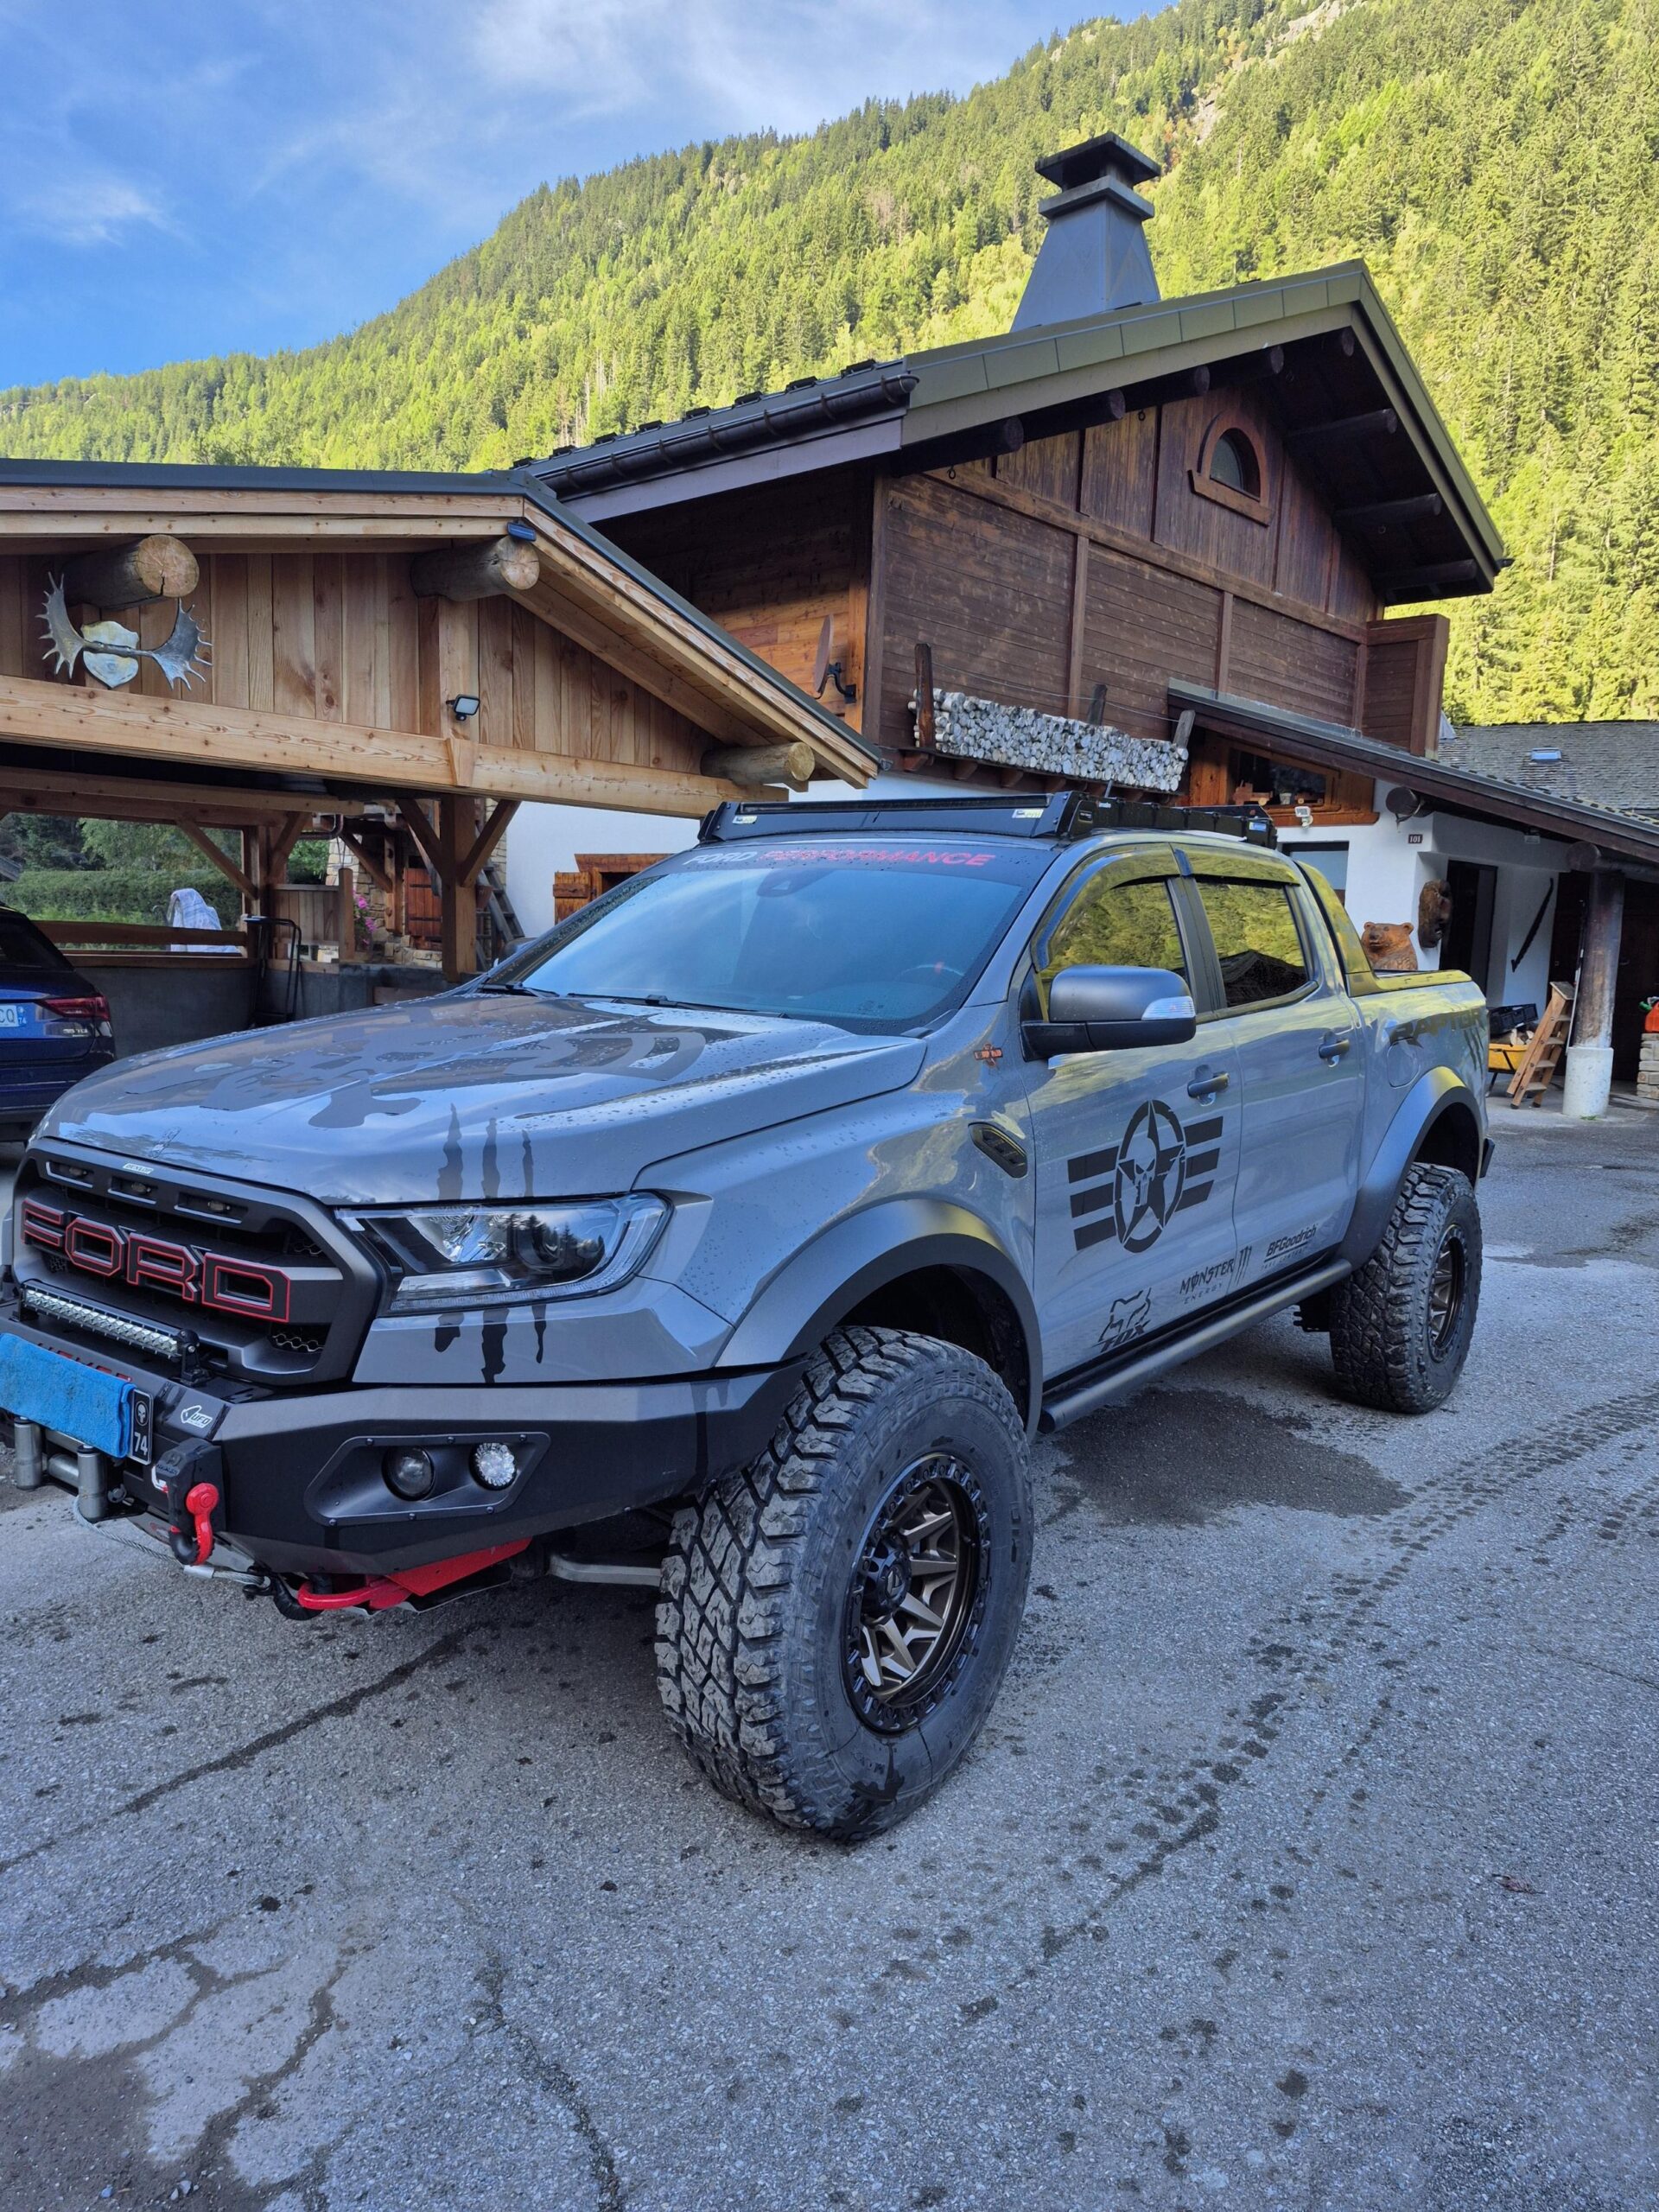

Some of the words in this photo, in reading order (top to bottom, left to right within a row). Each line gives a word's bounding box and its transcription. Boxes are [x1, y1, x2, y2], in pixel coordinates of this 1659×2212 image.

[683, 850, 758, 865] FORD
[758, 849, 996, 865] PERFORMANCE
[1265, 1224, 1318, 1257] BFGoodrich
[21, 1198, 290, 1323] FORD
[190, 1413, 212, 1425] UFO
[135, 1431, 148, 1456] 74
